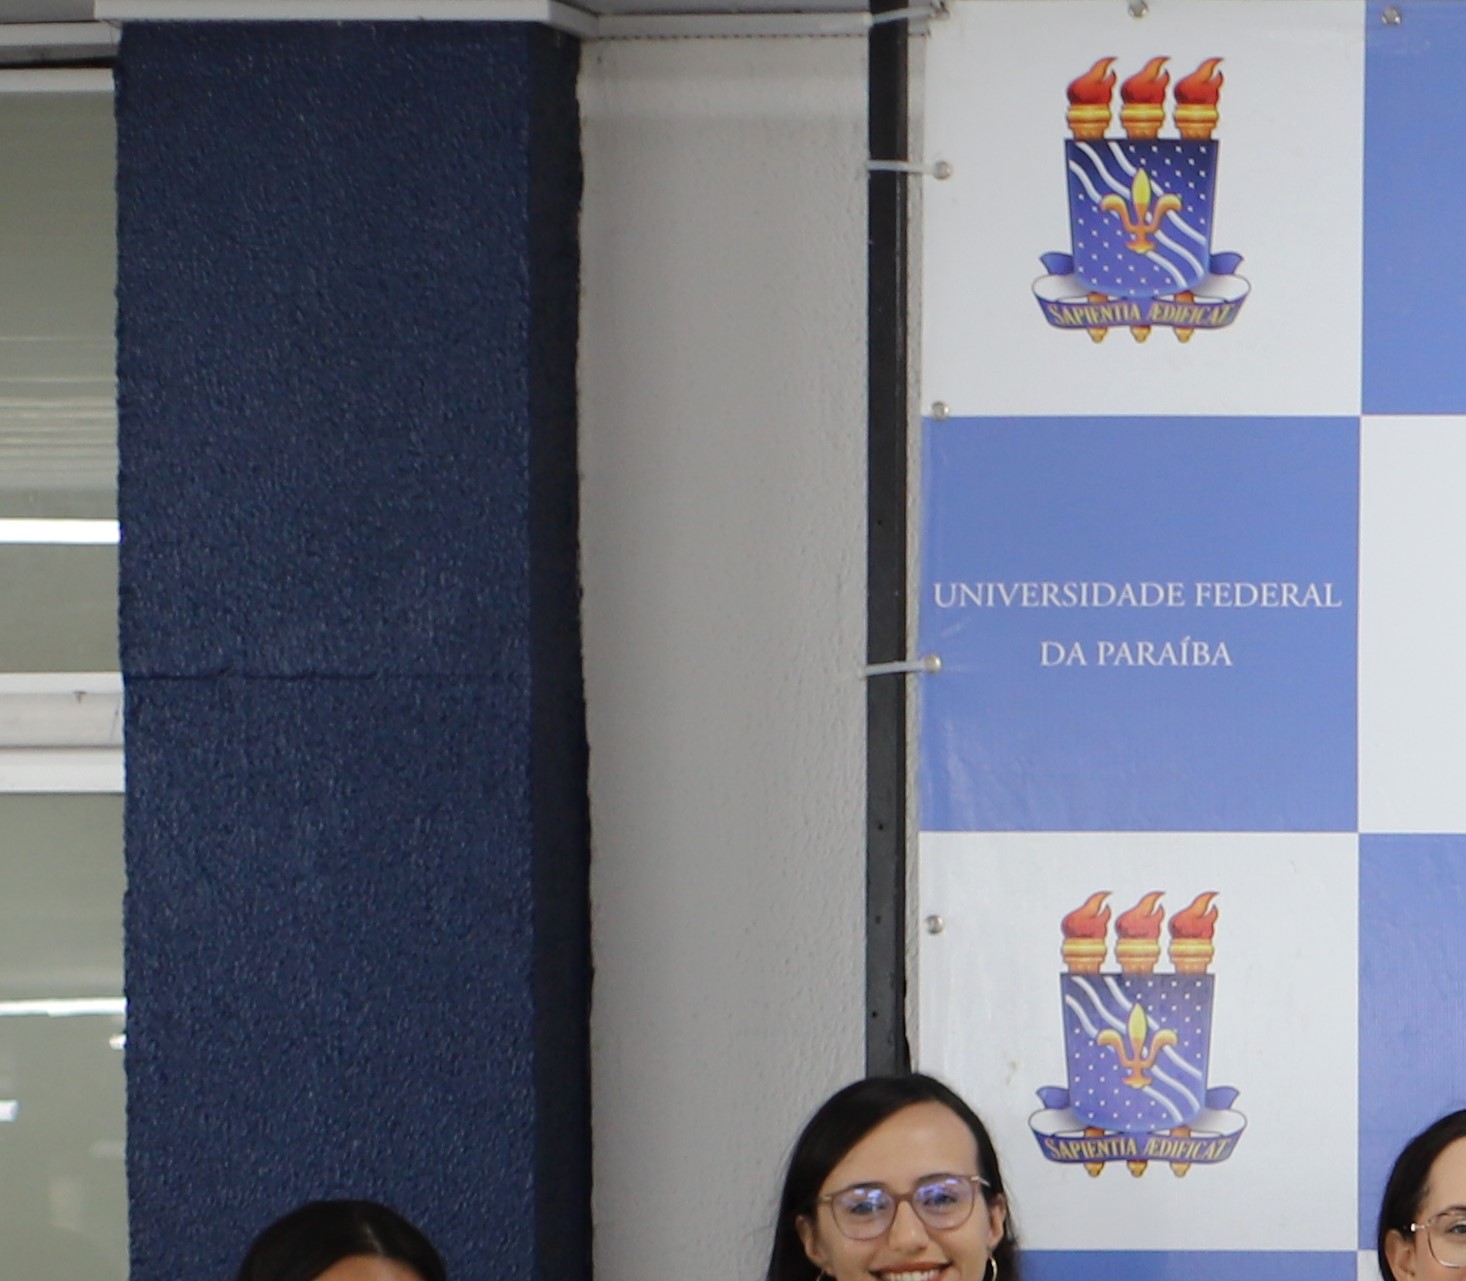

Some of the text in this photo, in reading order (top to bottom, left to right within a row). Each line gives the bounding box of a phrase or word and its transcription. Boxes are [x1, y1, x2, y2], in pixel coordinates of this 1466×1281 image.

[1047, 303, 1234, 326] SAPIENTIA ÆDIFICAT
[933, 581, 1342, 609] UNIVERSIDADE FEDERAL
[1040, 634, 1233, 667] DA PARAÍBA
[1044, 1138, 1231, 1161] SAPIENTIA ÆDIFICAT
